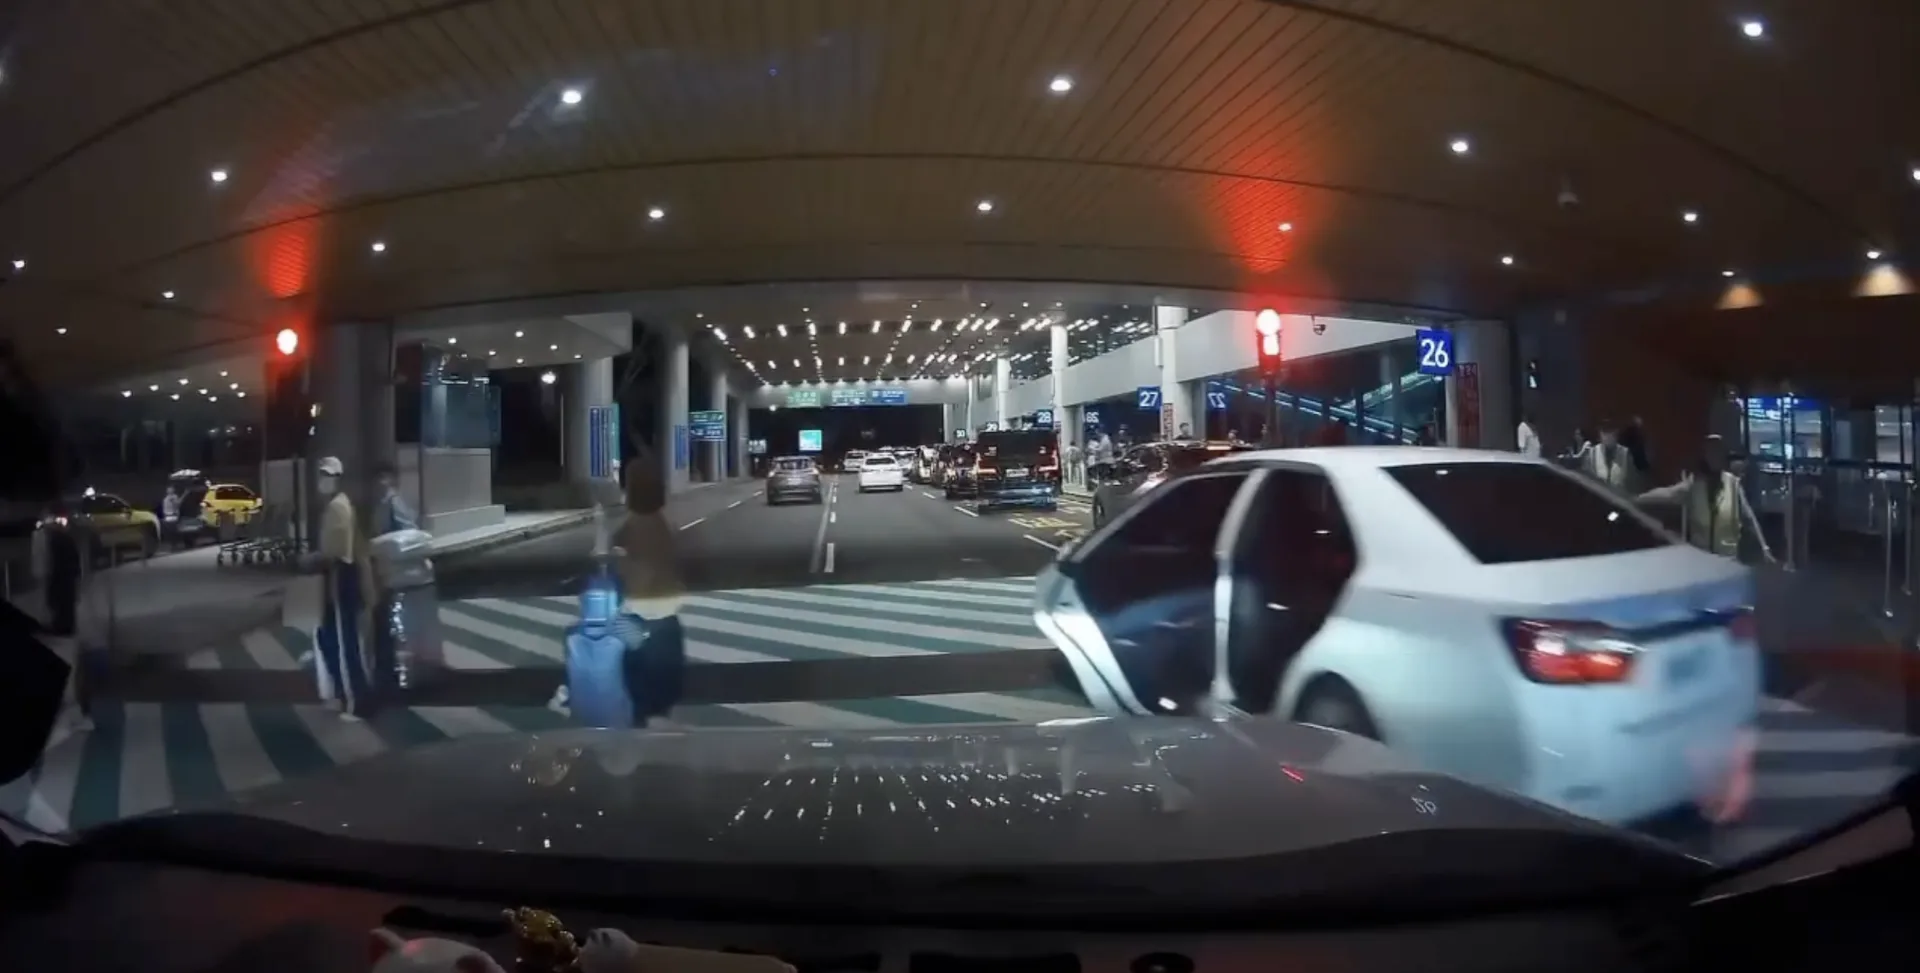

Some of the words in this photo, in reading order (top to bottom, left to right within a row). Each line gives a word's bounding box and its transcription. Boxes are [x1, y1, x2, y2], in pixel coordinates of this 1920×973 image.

[1420, 338, 1450, 368] 26
[1139, 391, 1159, 407] 27
[1037, 411, 1052, 423] 28
